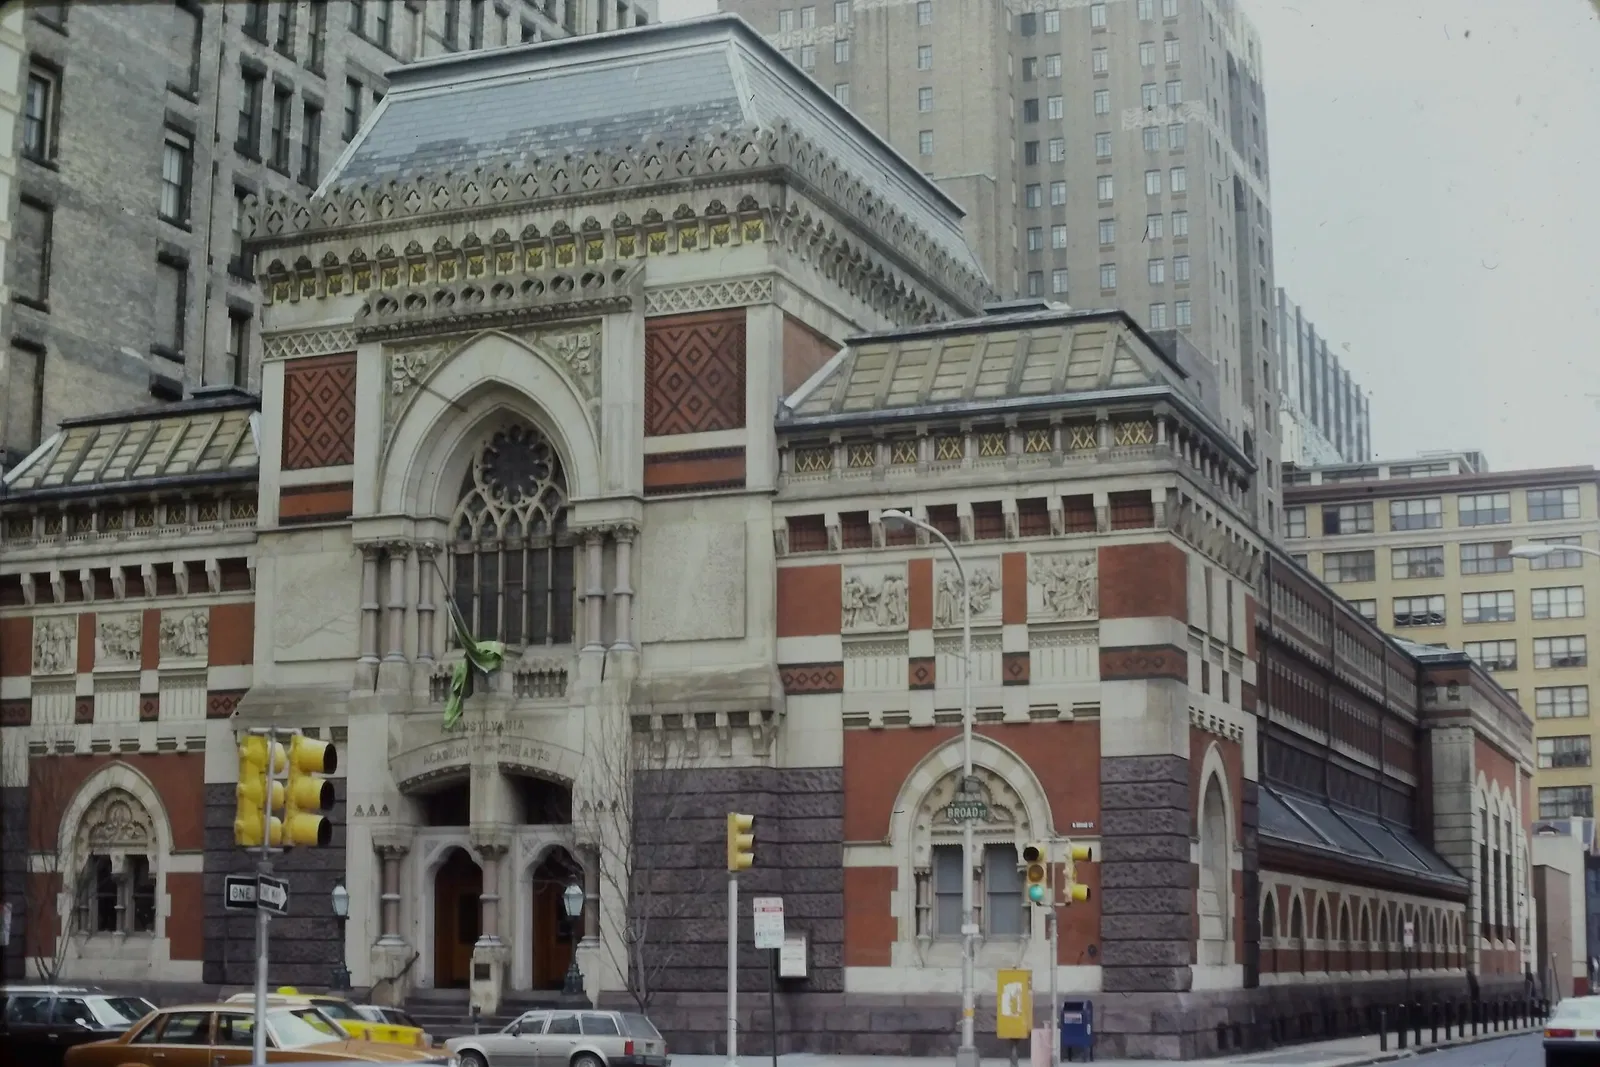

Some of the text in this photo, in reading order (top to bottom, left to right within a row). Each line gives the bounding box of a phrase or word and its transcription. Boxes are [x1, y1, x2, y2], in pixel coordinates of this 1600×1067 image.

[947, 807, 987, 818] BROAD ST
[231, 886, 252, 900] ONE
